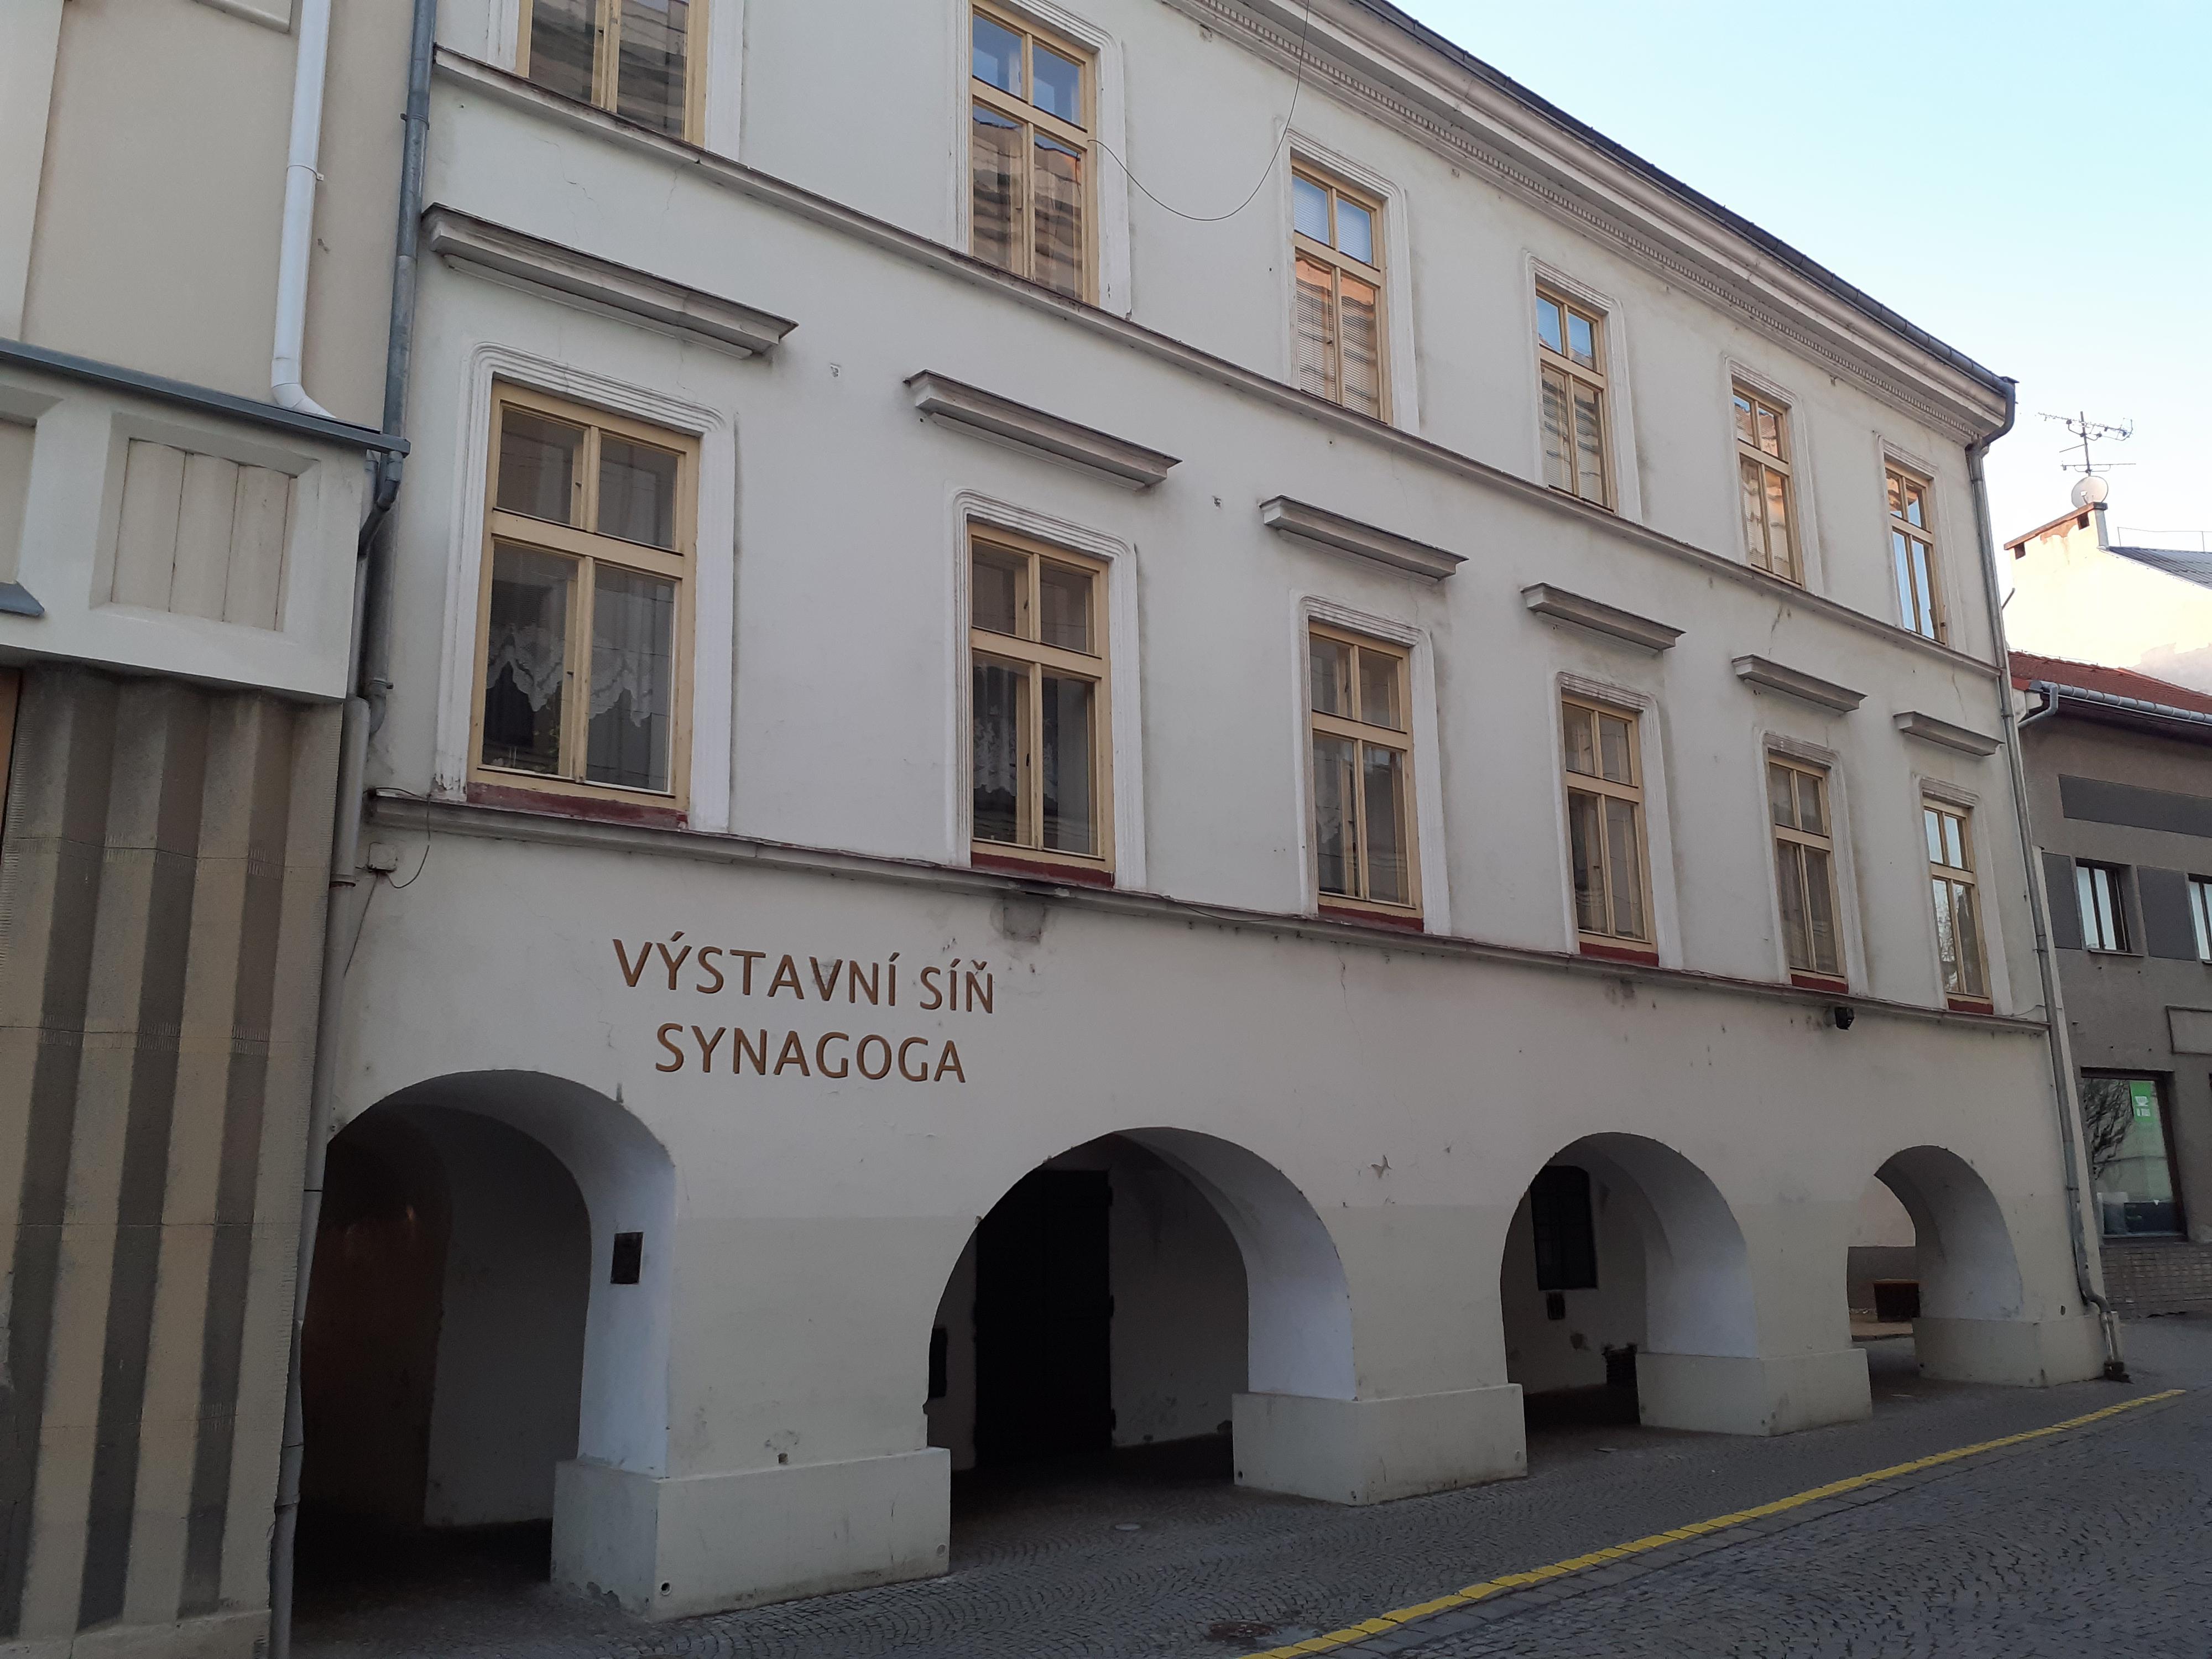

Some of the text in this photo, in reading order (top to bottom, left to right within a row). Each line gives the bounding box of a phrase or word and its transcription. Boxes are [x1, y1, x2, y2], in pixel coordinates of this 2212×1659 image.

[612, 931, 994, 1014] VÝSTAVNÍ SÍŇ
[655, 1022, 966, 1083] SYNAGOGA
